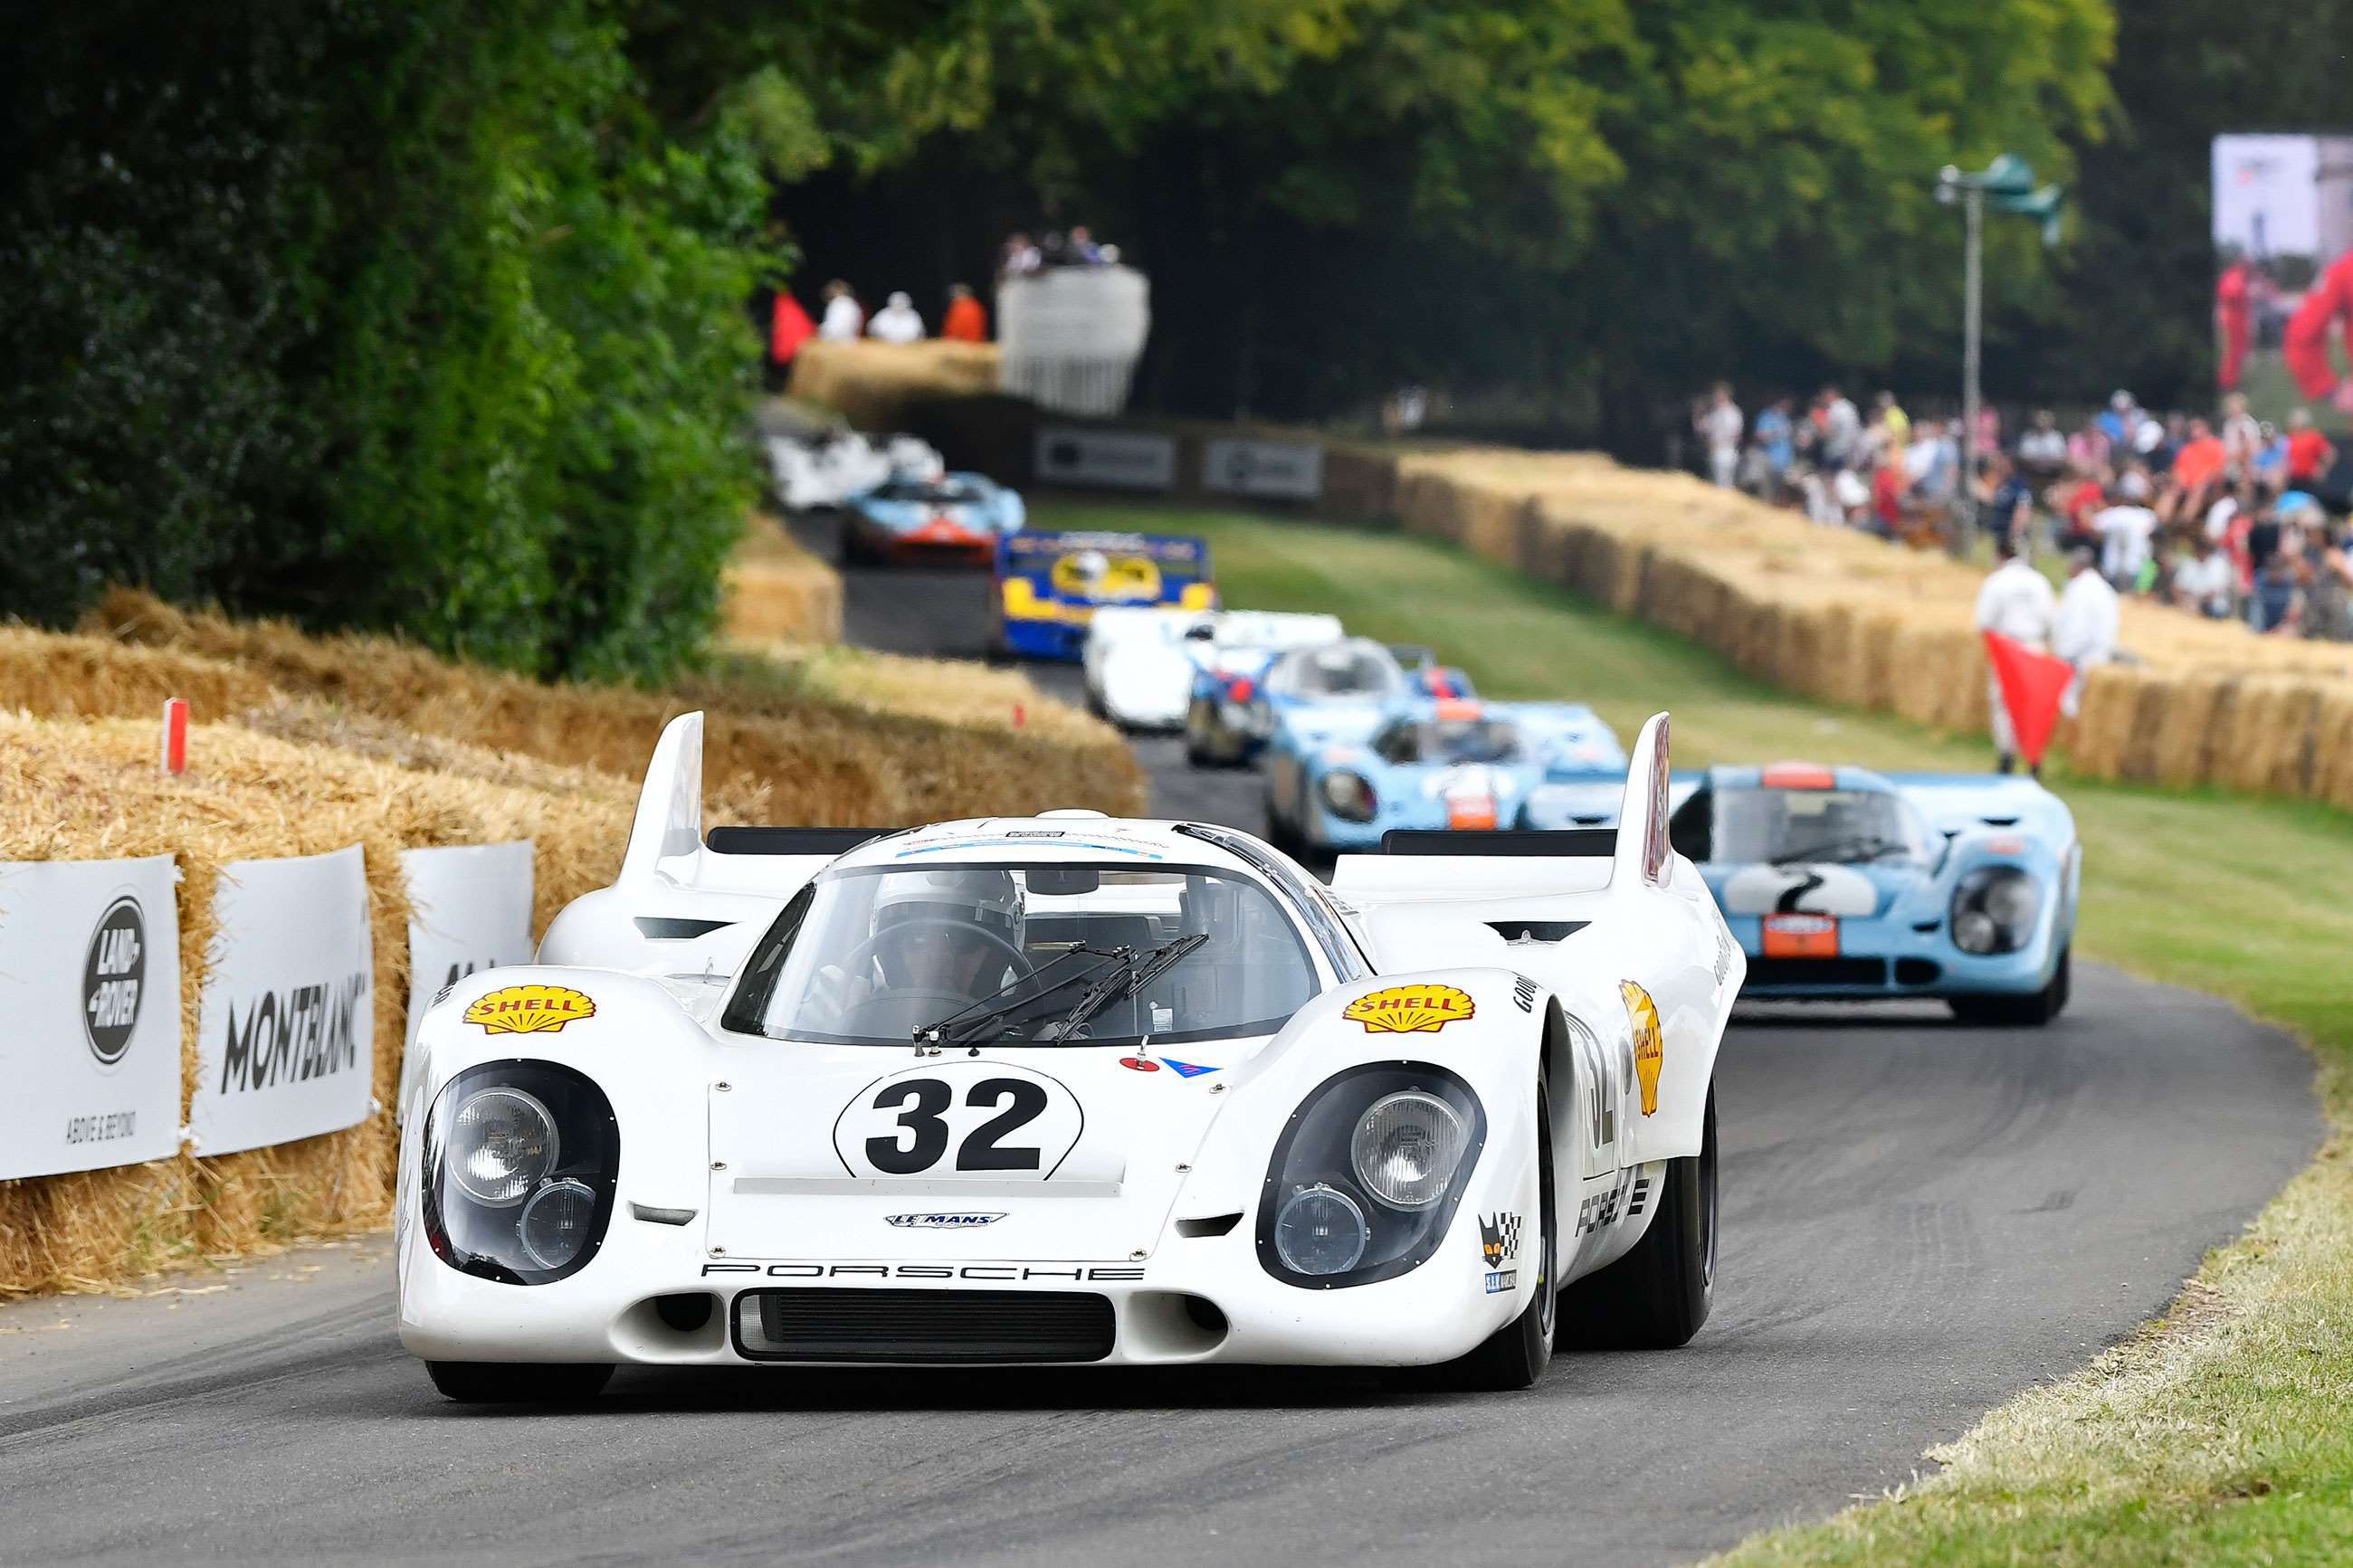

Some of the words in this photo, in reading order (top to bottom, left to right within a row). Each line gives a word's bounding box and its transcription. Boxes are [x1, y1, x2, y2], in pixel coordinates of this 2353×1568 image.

[1775, 872, 1829, 915] 2
[480, 999, 577, 1016] SHELL
[1359, 997, 1457, 1012] SHELL
[1635, 1026, 1659, 1061] SHELL
[865, 1078, 1048, 1175] 32
[893, 1215, 919, 1224] LE
[924, 1215, 991, 1224] MANS
[1575, 1178, 1651, 1238] PORSCHE
[701, 1263, 1146, 1281] PORSCHE
